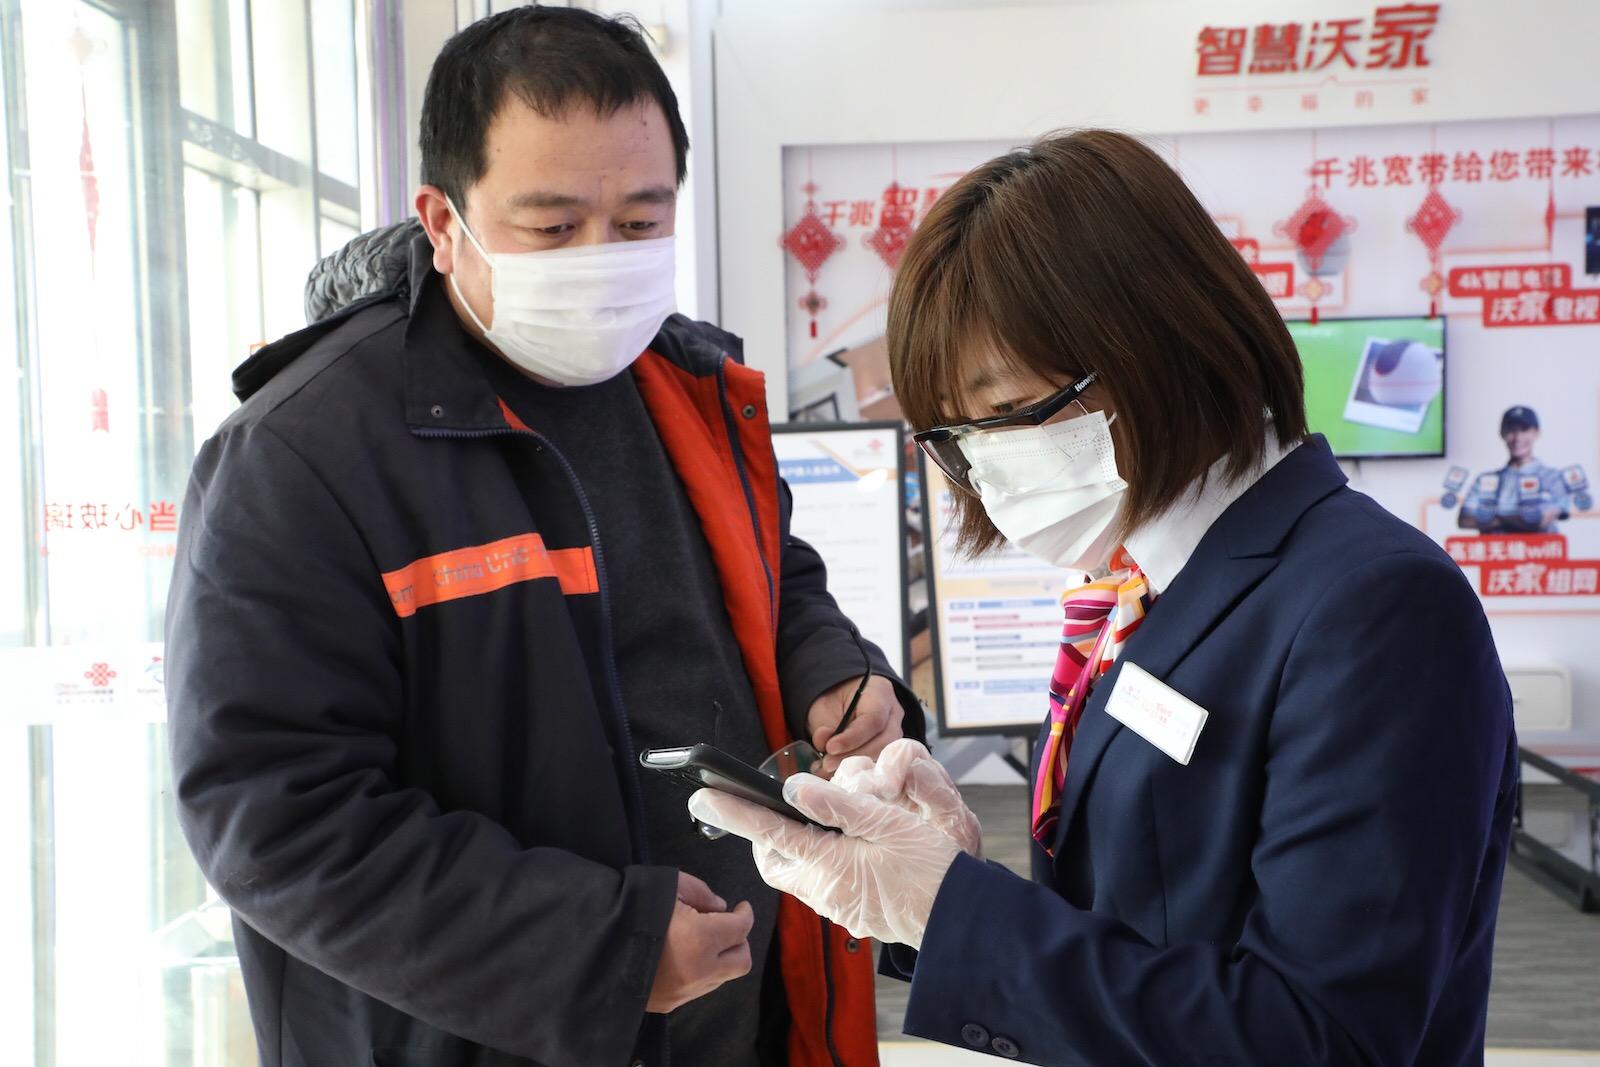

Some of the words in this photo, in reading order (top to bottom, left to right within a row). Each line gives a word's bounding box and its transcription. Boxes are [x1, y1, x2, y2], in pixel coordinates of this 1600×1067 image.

[1196, 3, 1441, 77] 智慧沃家
[1311, 146, 1600, 190] 千兆宽带给您带来
